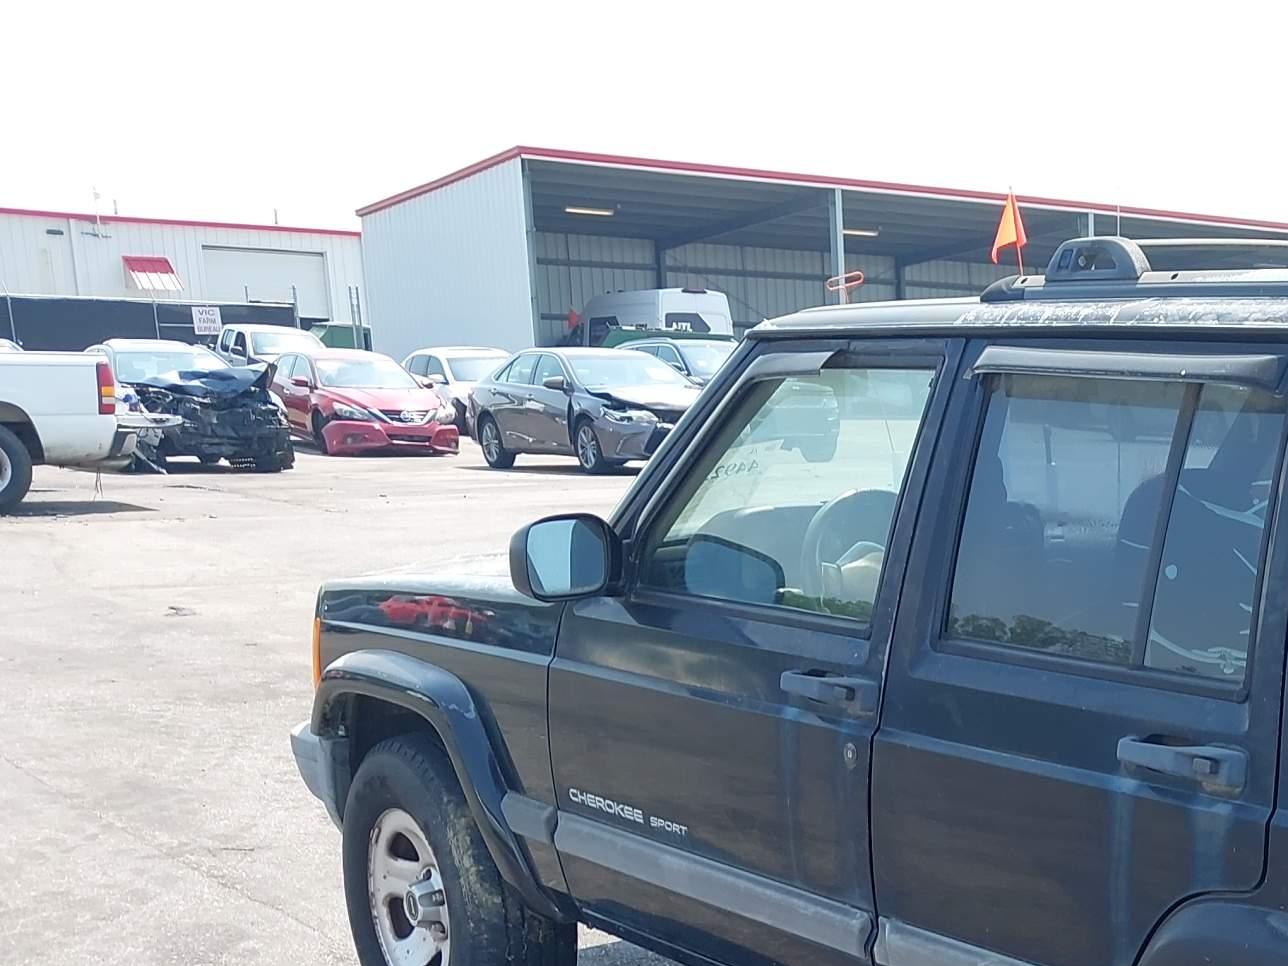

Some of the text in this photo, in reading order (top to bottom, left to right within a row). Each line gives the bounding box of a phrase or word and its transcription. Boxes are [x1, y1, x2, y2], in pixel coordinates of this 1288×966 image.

[198, 317, 217, 325] FARM
[568, 788, 688, 835] CHEROKEE SPORT
